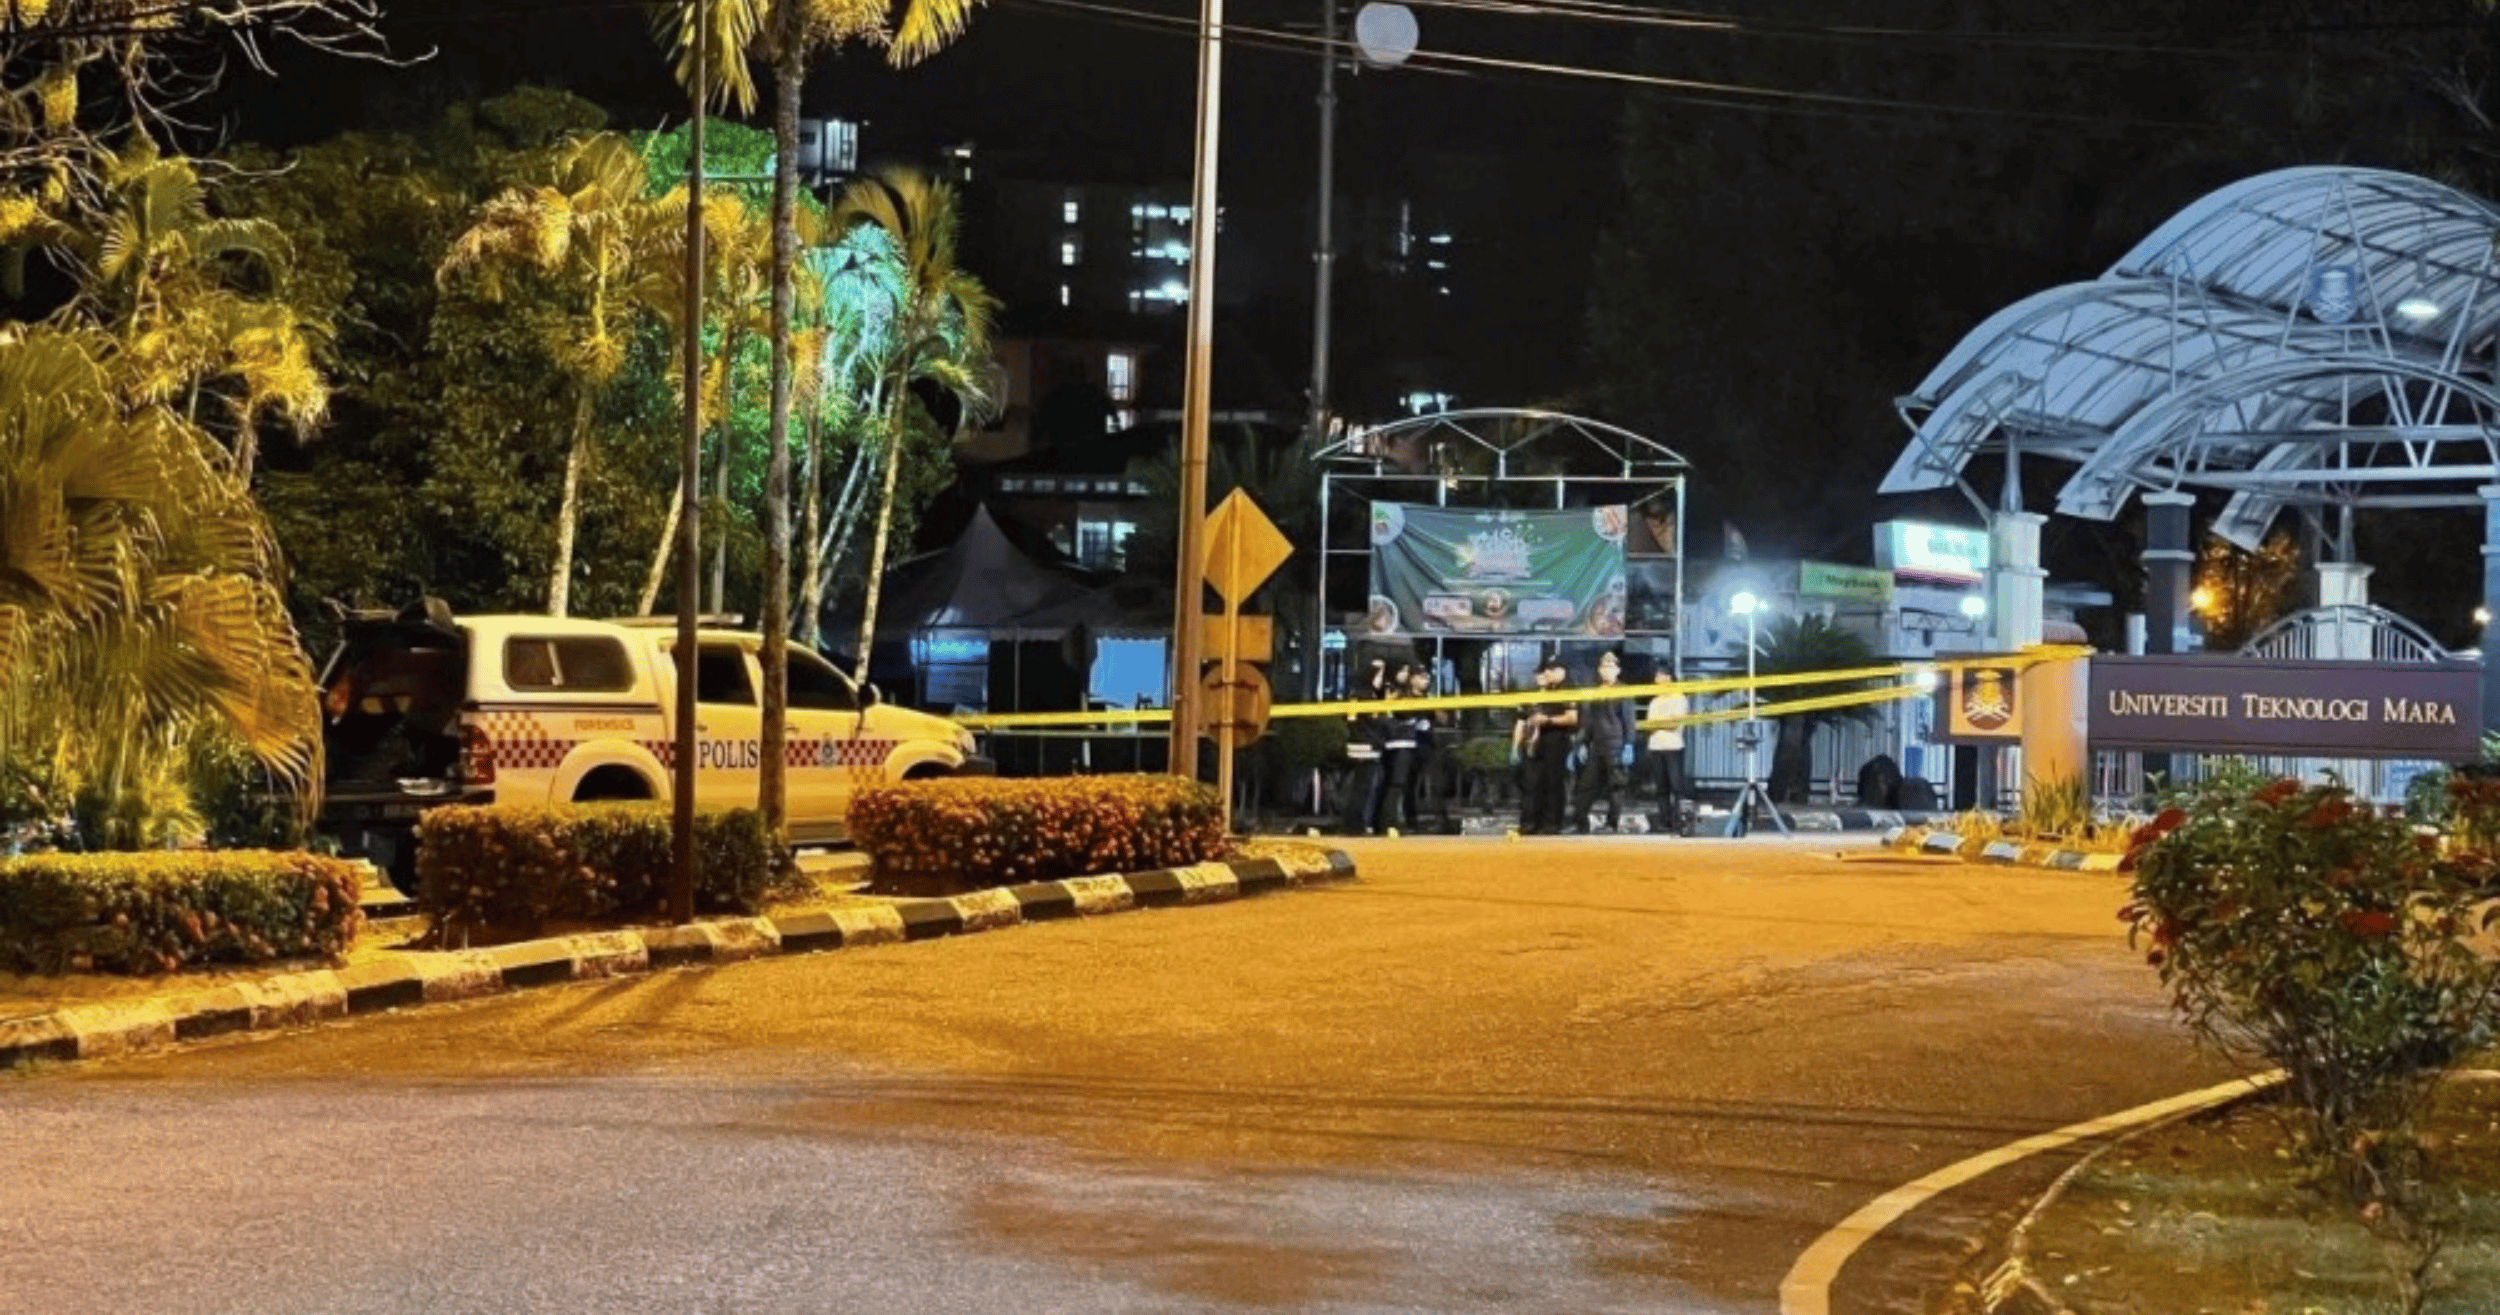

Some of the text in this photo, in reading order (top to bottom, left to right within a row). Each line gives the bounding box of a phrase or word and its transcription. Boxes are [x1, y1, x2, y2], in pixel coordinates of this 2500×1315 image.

[2109, 690, 2456, 725] UNIVERSITI TEKNOLOGI MARA
[698, 739, 759, 768] POLIS
